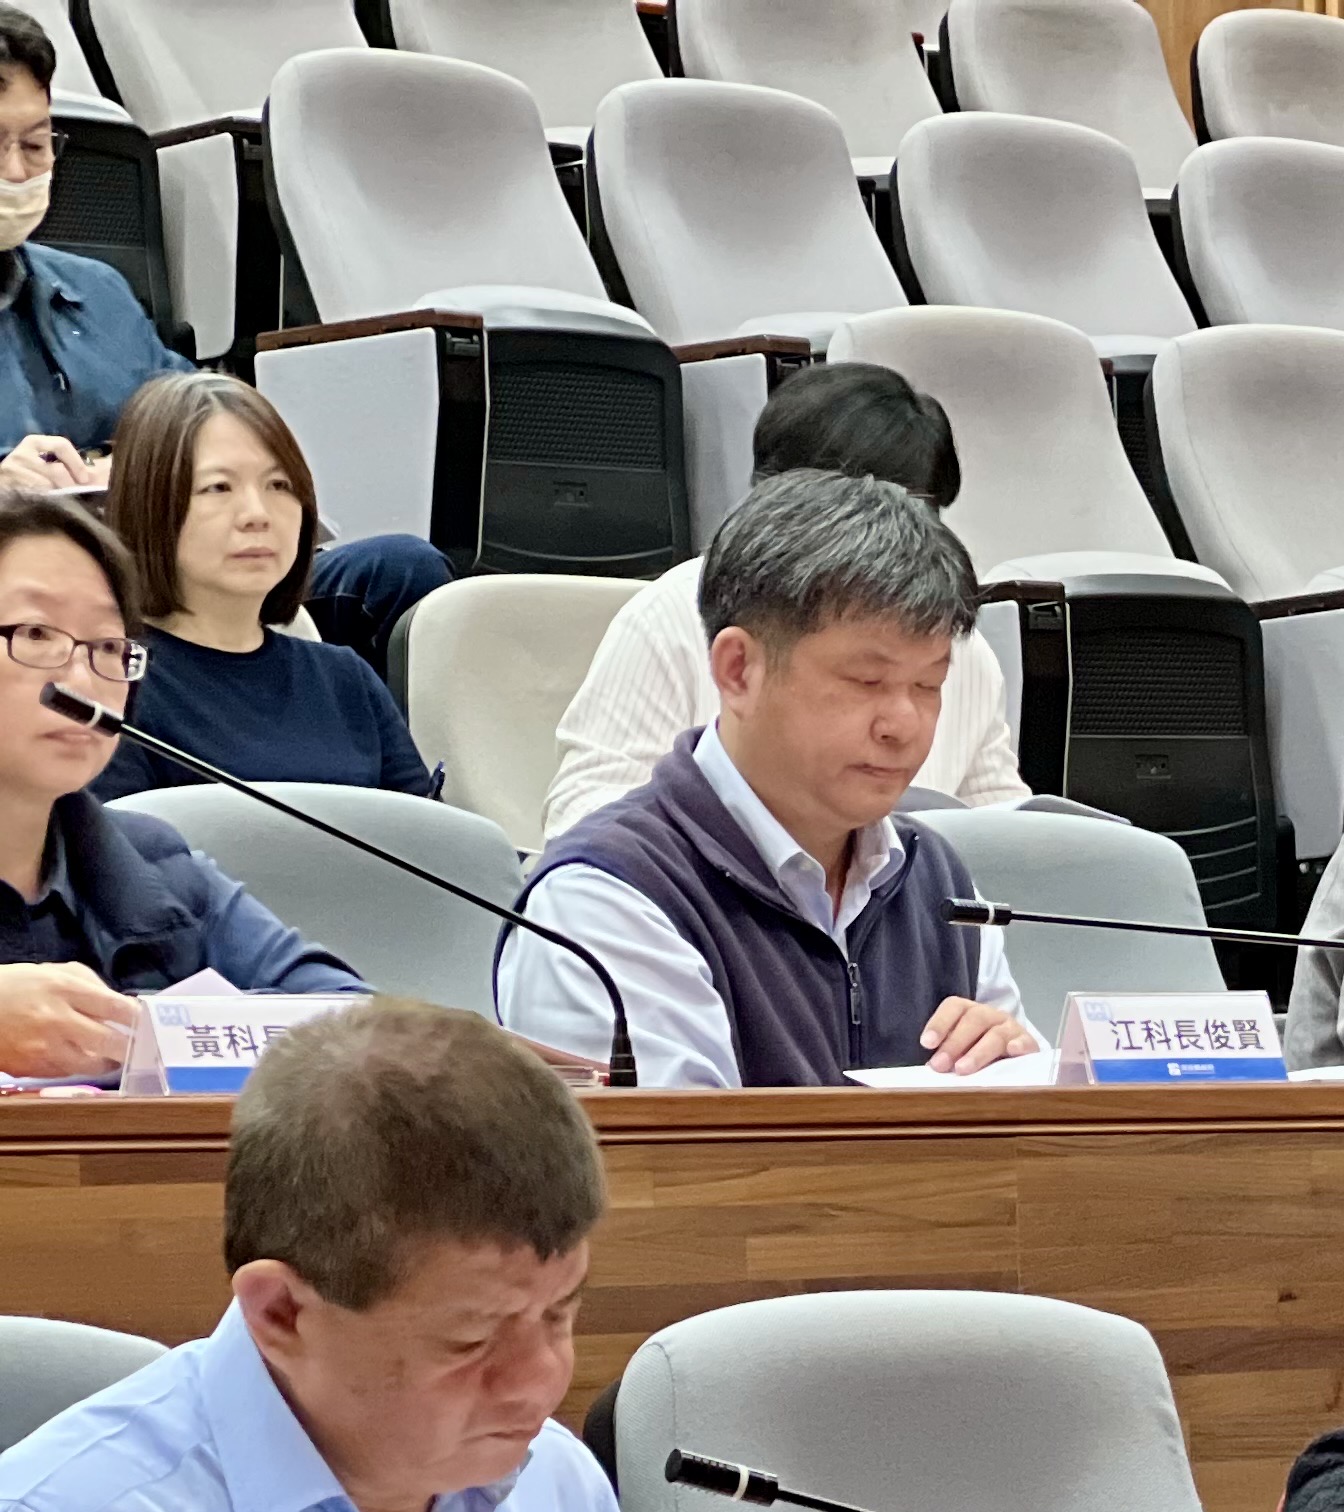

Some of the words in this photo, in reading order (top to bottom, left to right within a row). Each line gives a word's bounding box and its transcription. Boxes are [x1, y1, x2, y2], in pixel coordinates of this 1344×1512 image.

[1109, 1018, 1265, 1051] 江科長俊賢
